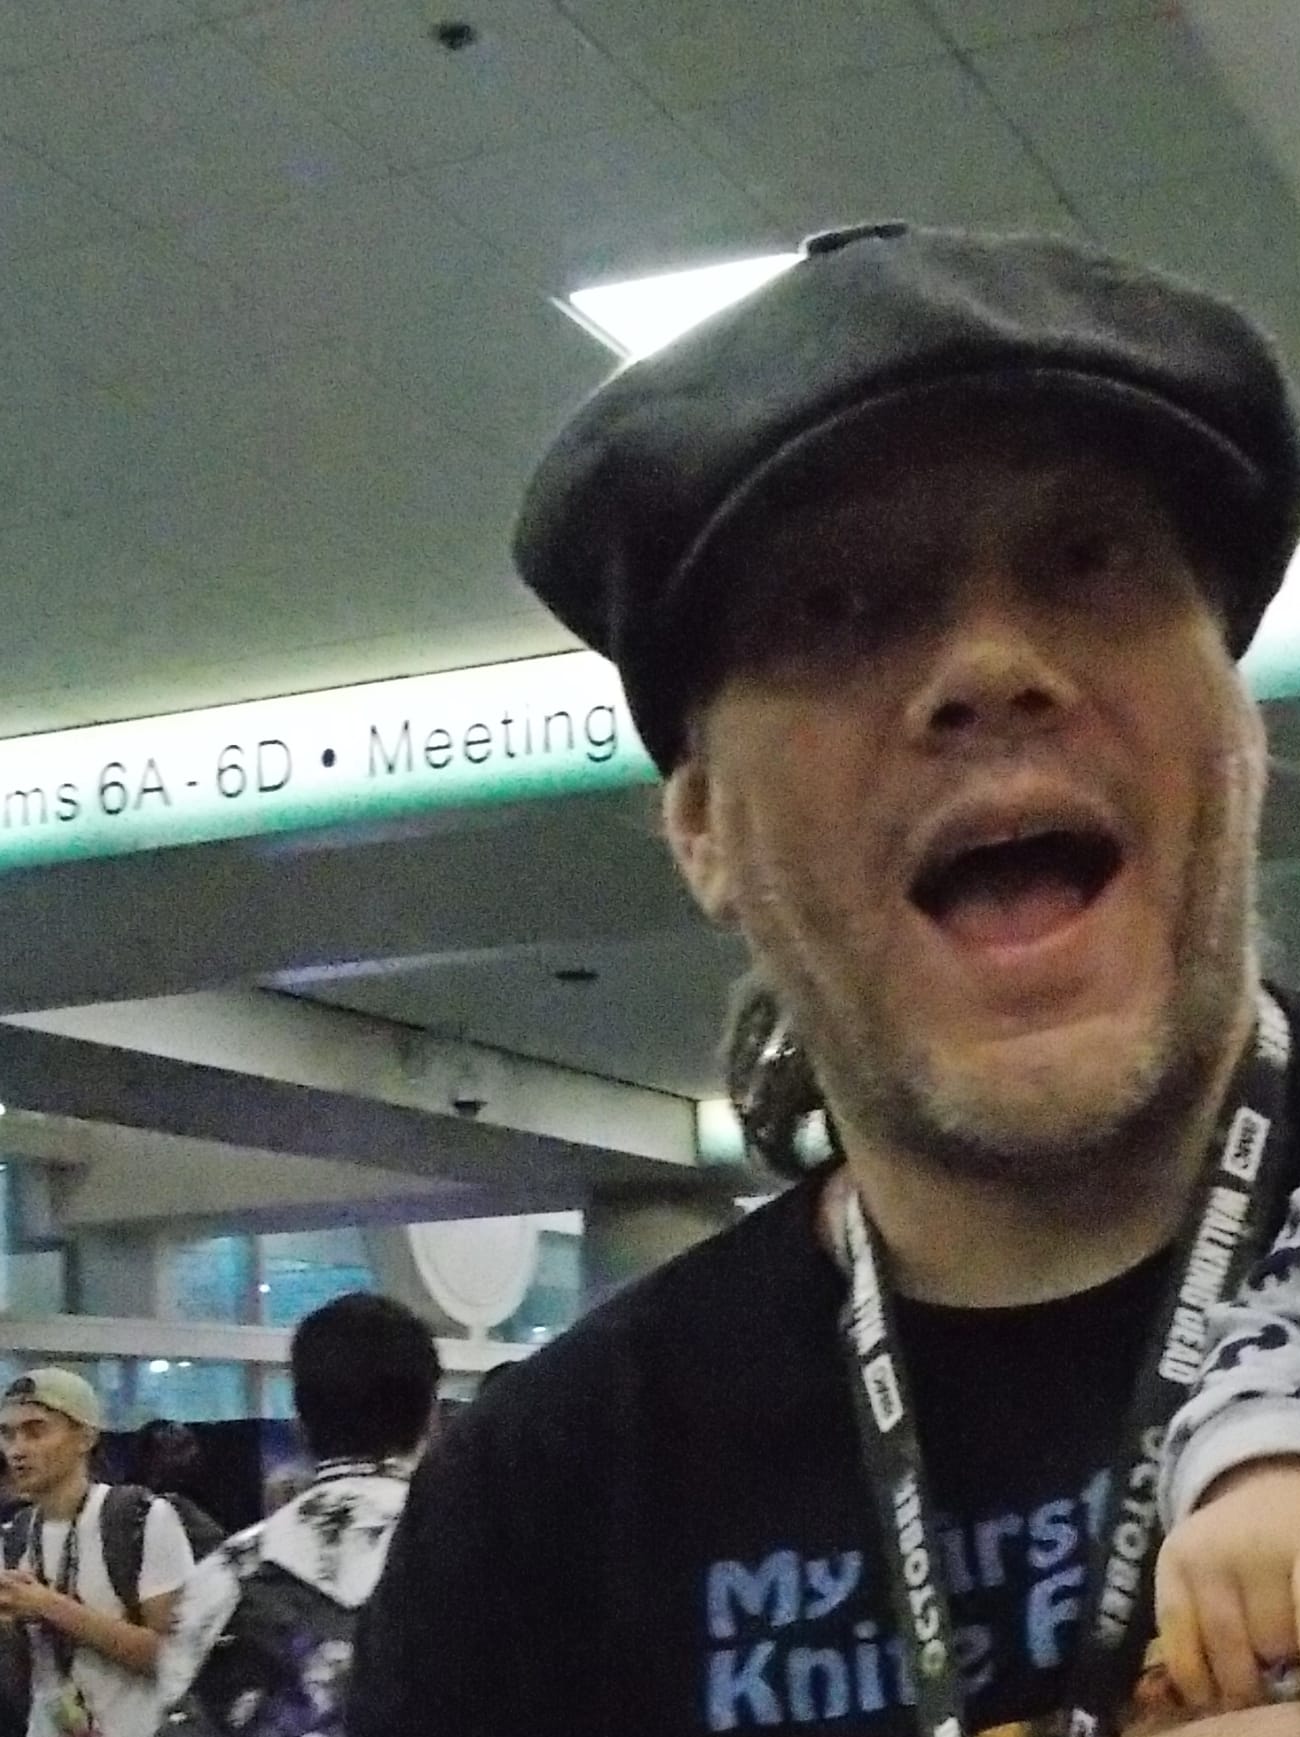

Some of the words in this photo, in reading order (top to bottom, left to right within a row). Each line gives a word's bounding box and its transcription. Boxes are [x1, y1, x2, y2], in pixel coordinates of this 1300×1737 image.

[98, 758, 171, 816] 6A
[216, 738, 293, 799] 6D
[368, 703, 619, 777] Meeting
[706, 1548, 864, 1640] My
